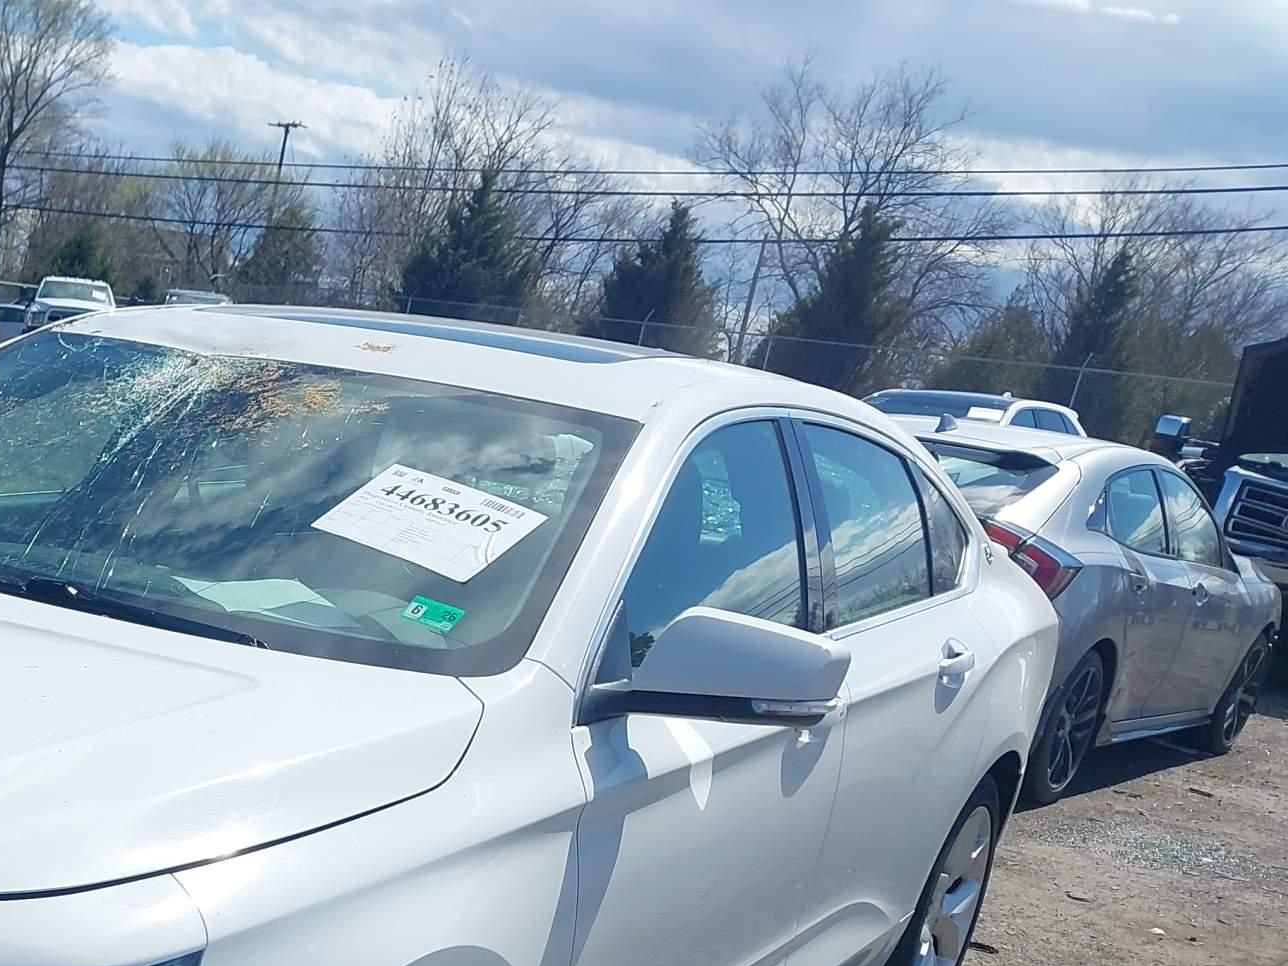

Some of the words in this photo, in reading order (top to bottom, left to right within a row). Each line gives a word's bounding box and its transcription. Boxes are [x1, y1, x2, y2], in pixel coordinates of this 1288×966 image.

[381, 484, 509, 533] 44683605
[411, 604, 423, 615] 6
[442, 610, 457, 622] 26
